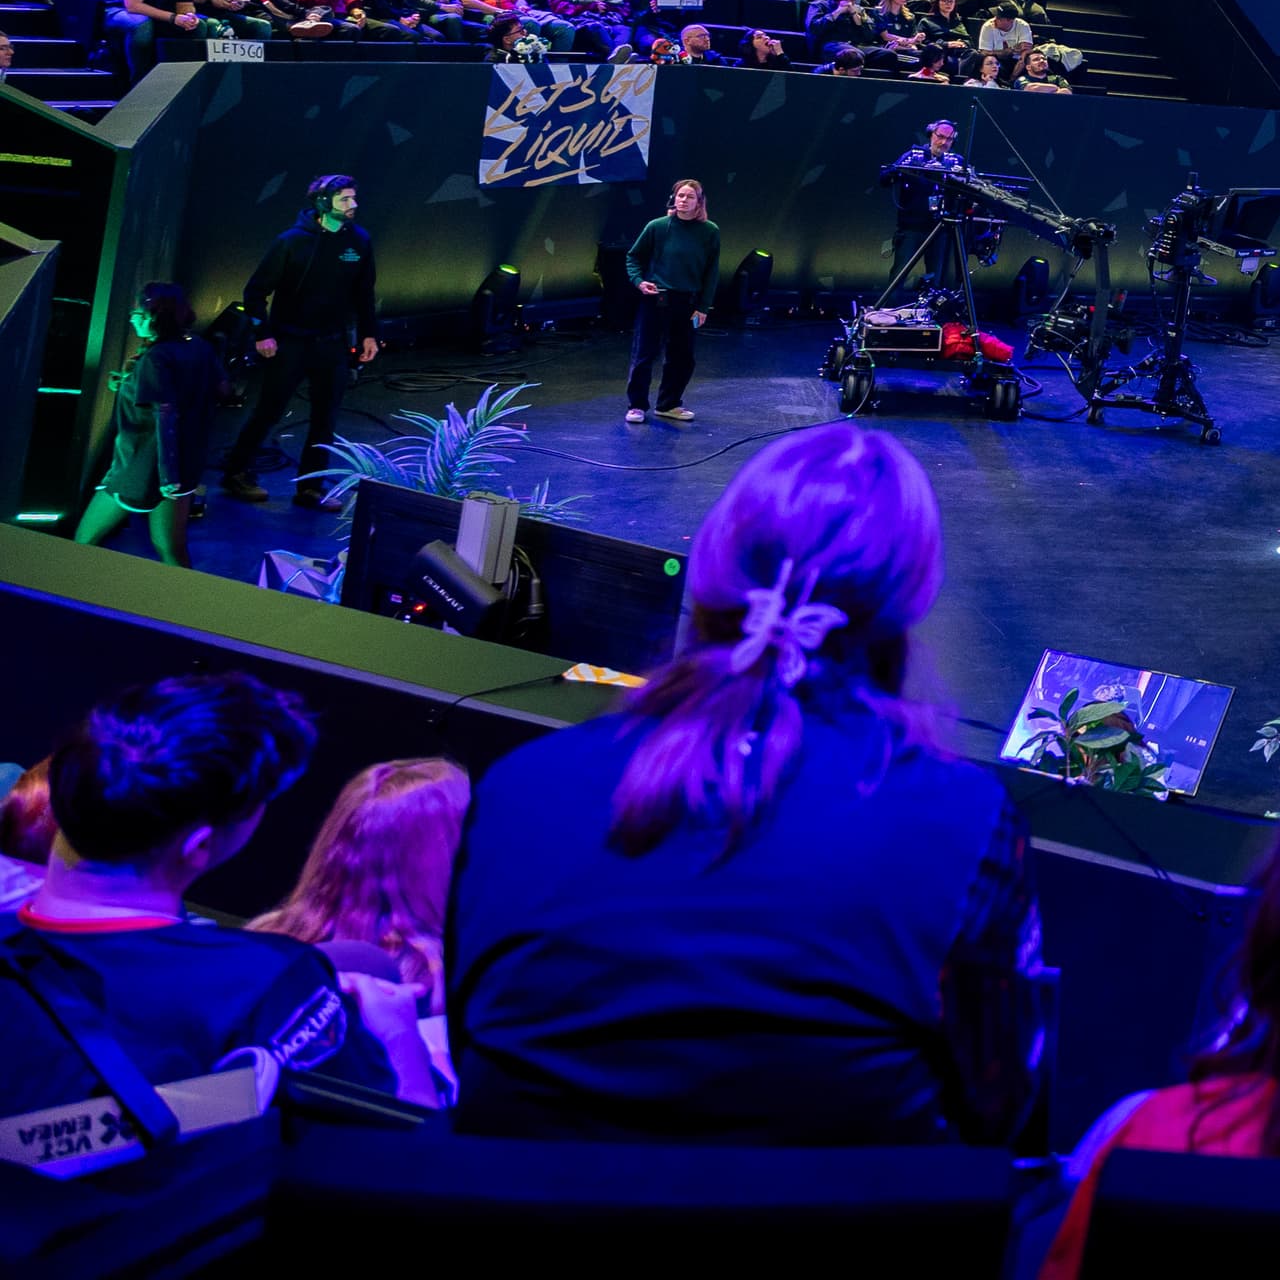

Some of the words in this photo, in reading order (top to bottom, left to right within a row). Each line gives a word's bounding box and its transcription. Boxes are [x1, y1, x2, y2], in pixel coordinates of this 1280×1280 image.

[600, 64, 657, 110] GO
[18, 1114, 92, 1145] EMEA
[39, 1135, 92, 1160] VCT
